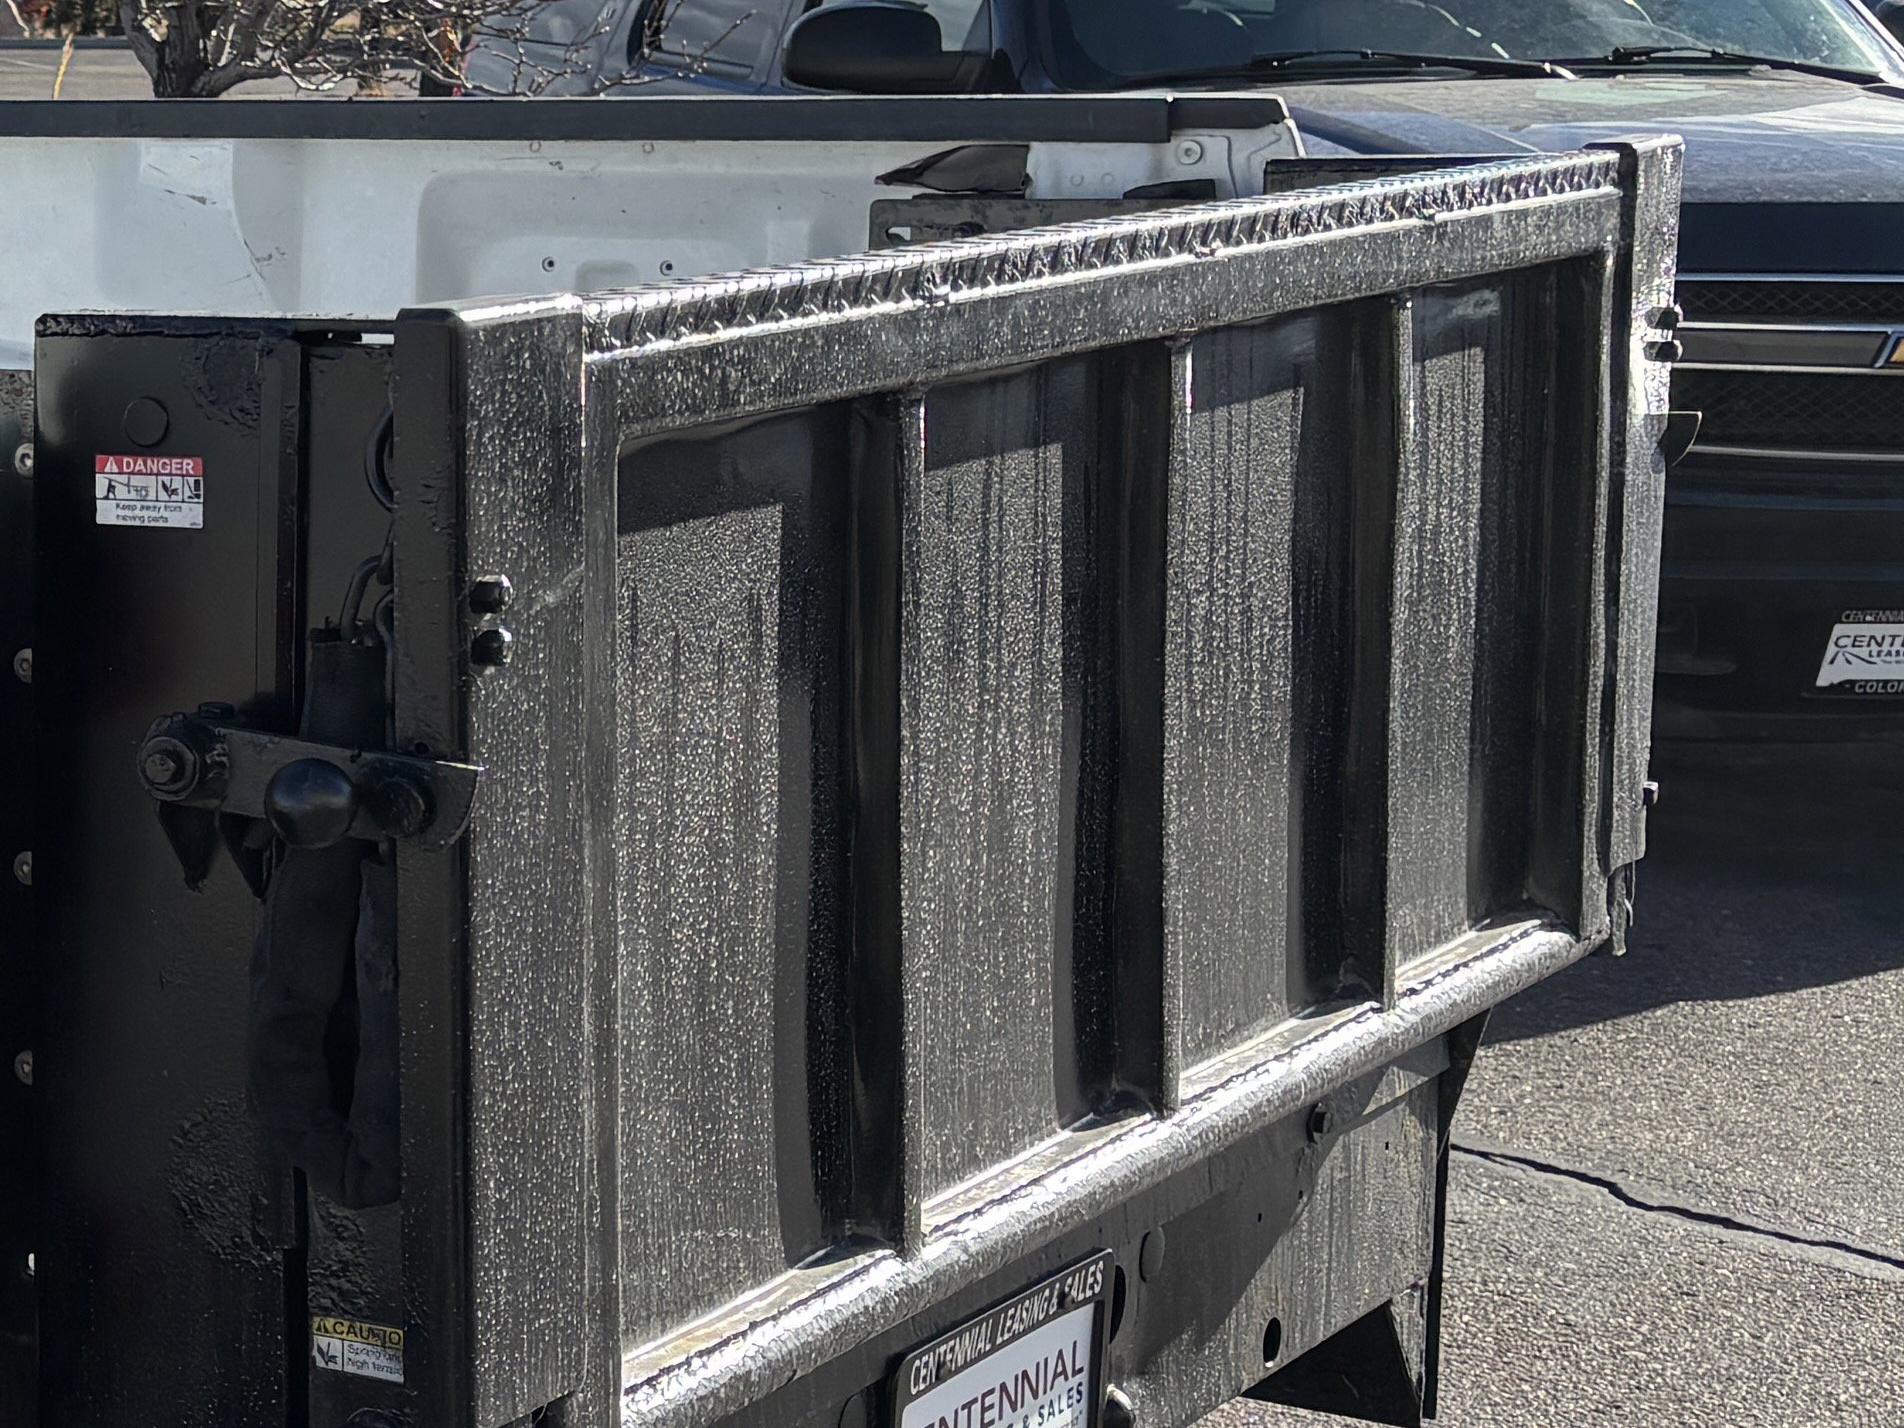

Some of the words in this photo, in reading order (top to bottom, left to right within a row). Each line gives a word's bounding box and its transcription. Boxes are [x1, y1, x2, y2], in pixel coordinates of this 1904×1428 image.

[122, 458, 195, 475] DANGER
[115, 503, 138, 513] Keep
[995, 1287, 1050, 1344] LEASING
[1049, 1282, 1060, 1315] &
[1037, 1381, 1084, 1427] SALES
